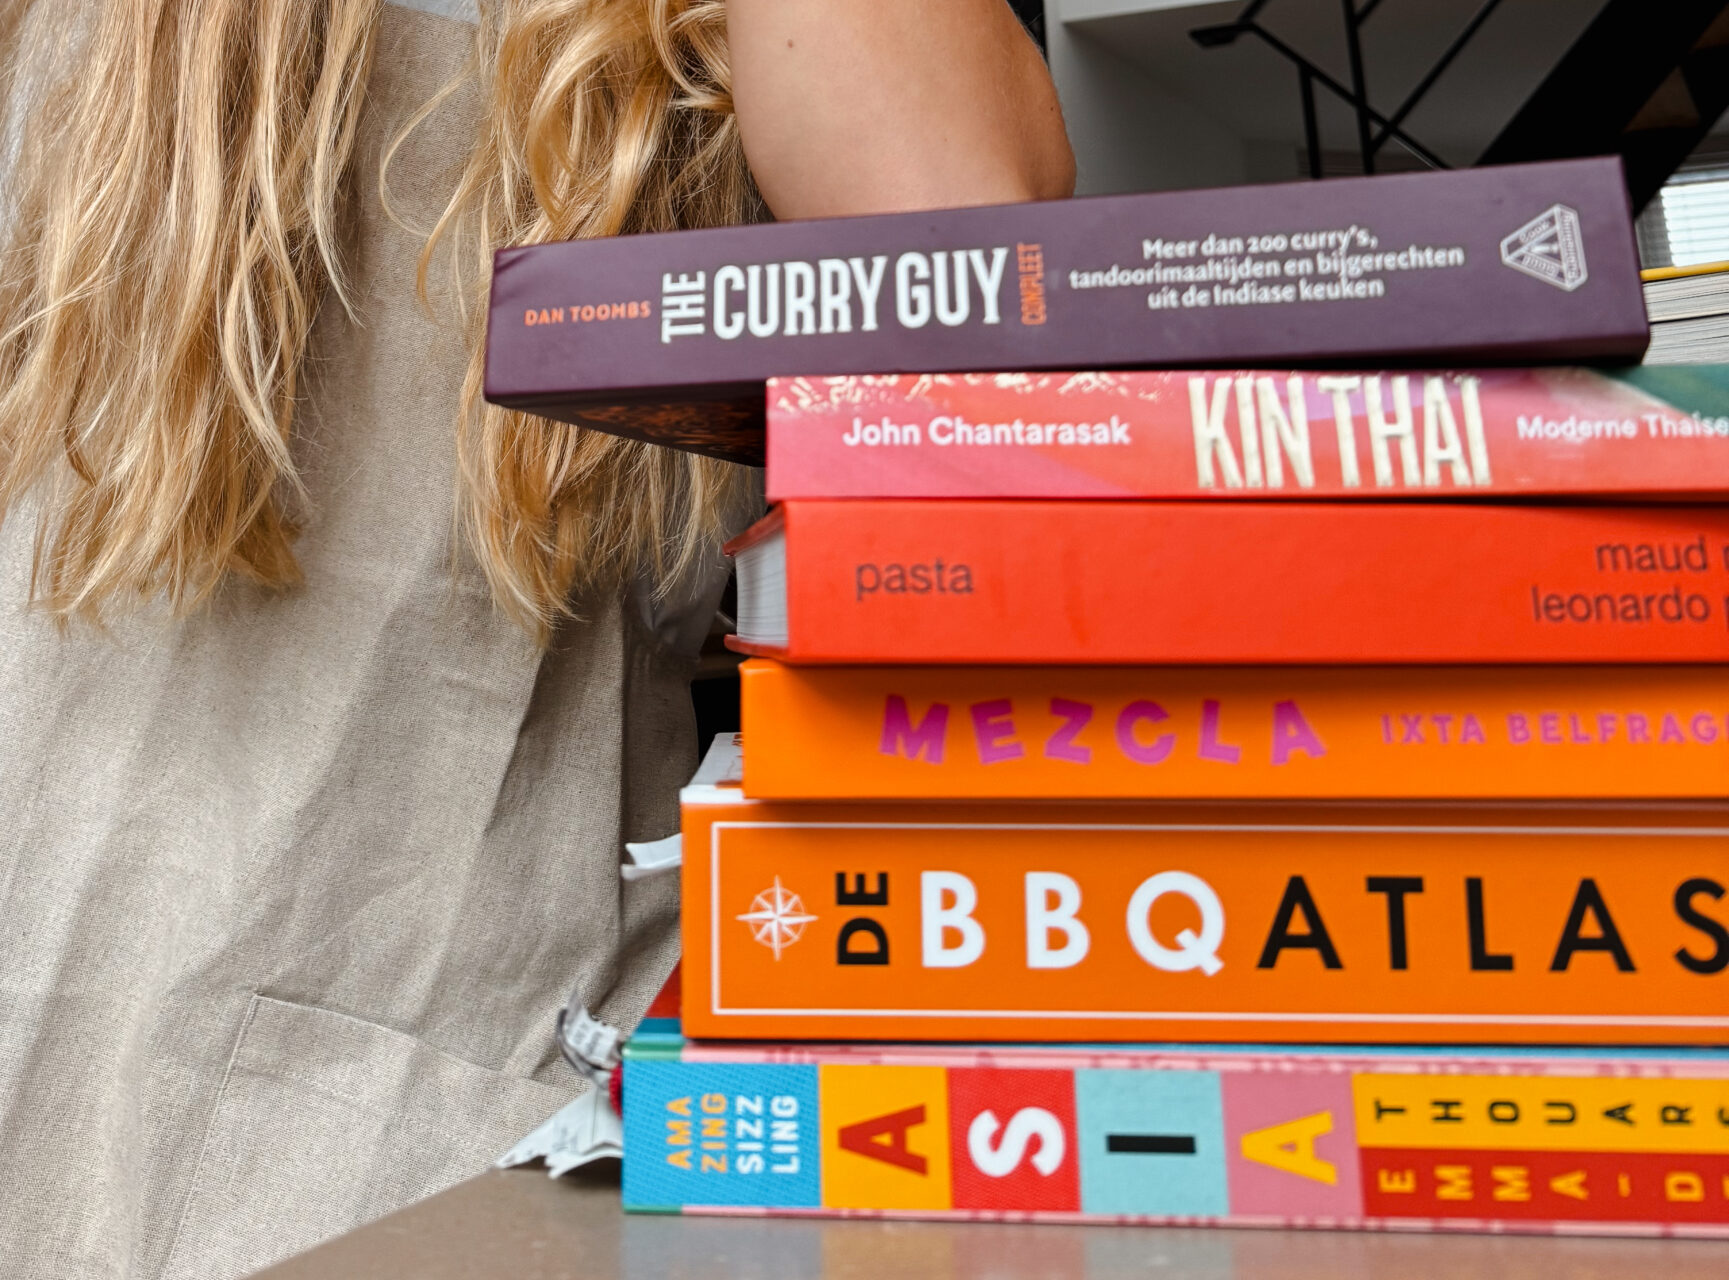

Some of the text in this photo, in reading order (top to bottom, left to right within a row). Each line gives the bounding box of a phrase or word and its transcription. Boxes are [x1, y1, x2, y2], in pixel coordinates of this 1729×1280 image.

[1143, 225, 1378, 258] Meer dan 200 curry's,
[1016, 243, 1047, 325] COMPLEET
[1068, 245, 1464, 290] tandoorimaaltijden en bijgerechten
[524, 300, 652, 327] DAN TOOMBS
[661, 247, 1009, 344] THE CURRY GUY
[1148, 277, 1385, 310] uit de Indiase keuken
[842, 415, 1131, 447] John Chantarasak
[1188, 374, 1492, 490] KIN THAI
[1516, 410, 1729, 440] Moderne Thaise
[1595, 534, 1709, 572] maud
[855, 557, 974, 602] pasta
[1530, 584, 1711, 623] leonardo
[879, 693, 1328, 766] MEZCLA
[1381, 713, 1487, 745] IXTA
[836, 870, 1729, 977] DE BBQ ATLAS
[666, 1096, 693, 1170] AMA
[701, 1093, 728, 1173] ZING
[736, 1094, 764, 1175] SIZZ
[771, 1094, 801, 1174] LING
[1378, 1164, 1729, 1204] EMMA-D
